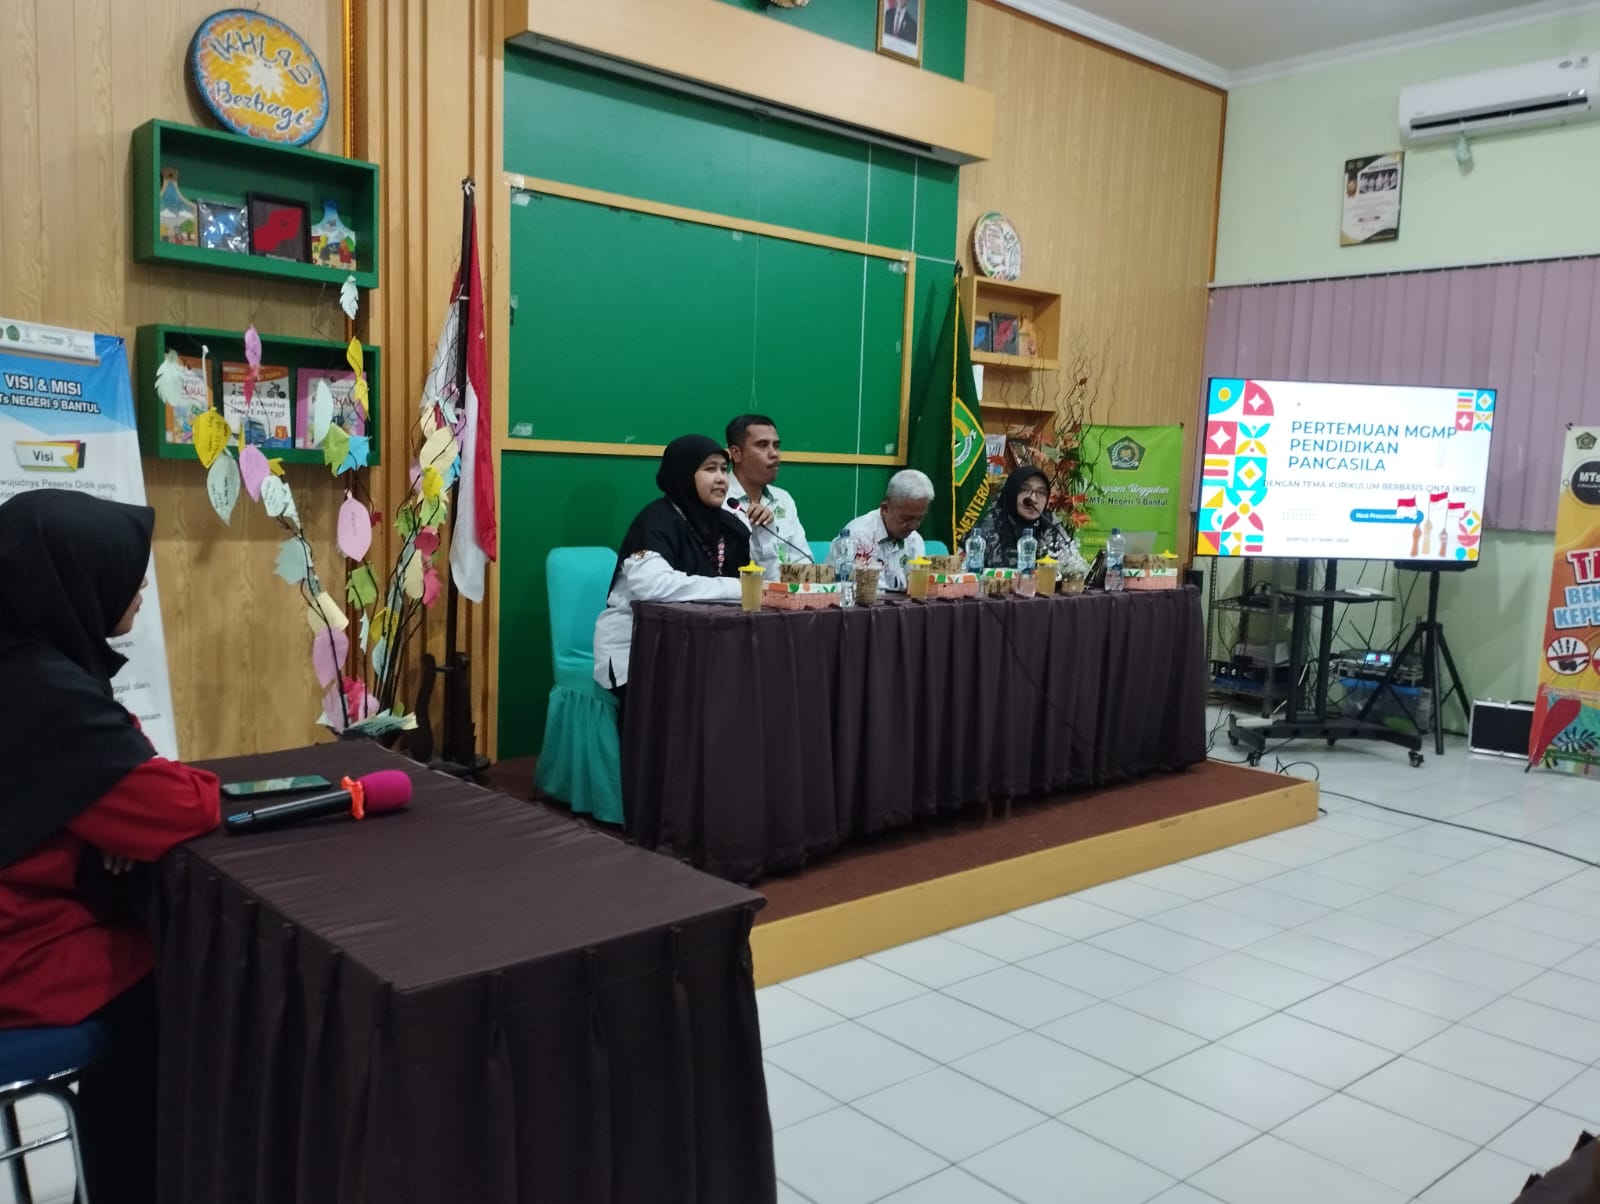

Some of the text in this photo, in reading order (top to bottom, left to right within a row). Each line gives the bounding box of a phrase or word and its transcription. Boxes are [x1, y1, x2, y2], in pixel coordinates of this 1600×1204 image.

[215, 80, 311, 130] Berbagi
[4, 373, 82, 396] VISI & MISI
[11, 394, 51, 410] NEGERI
[52, 400, 60, 410] 9
[61, 402, 100, 414] BANTUL
[1291, 421, 1458, 440] PERTEMUAN MGMP
[1290, 438, 1399, 455] PENDIDIKAN
[33, 450, 54, 462] Visi
[1288, 456, 1387, 472] PANCASILA
[41, 479, 73, 489] Peserta
[1302, 480, 1326, 489] TEMA
[1382, 482, 1424, 492] BERBASIS
